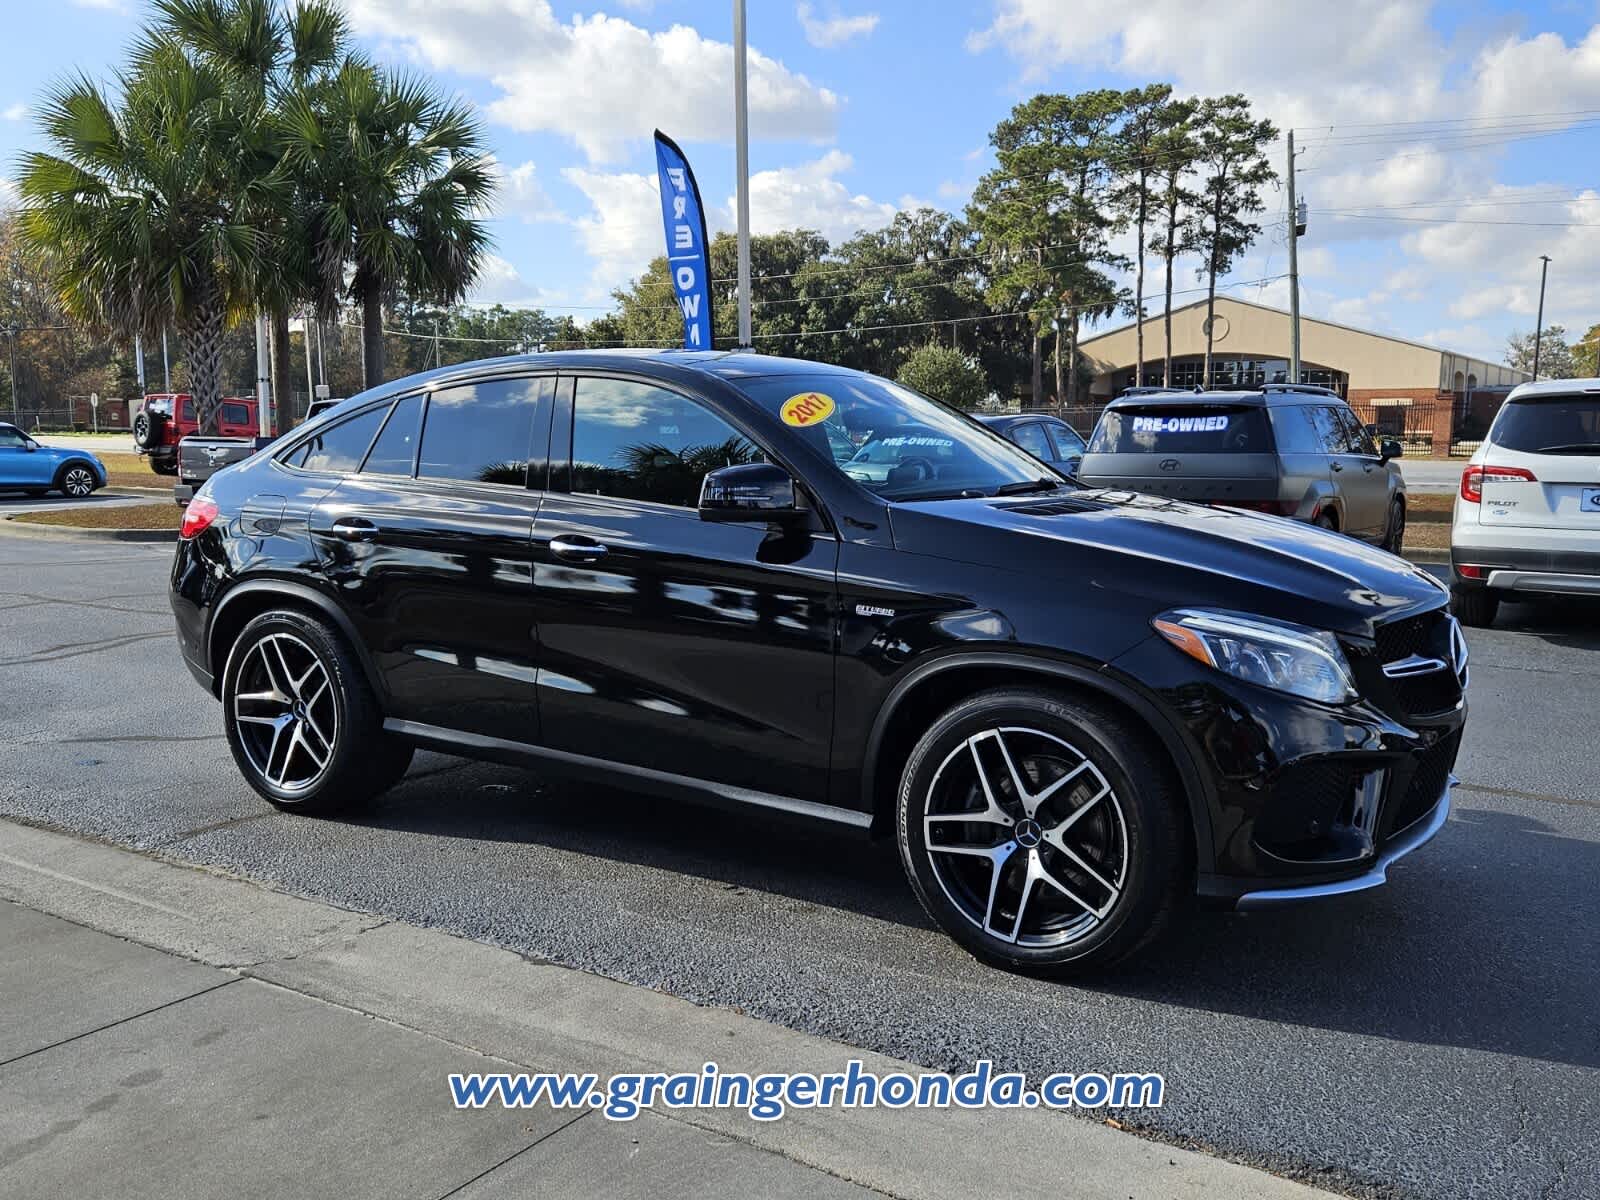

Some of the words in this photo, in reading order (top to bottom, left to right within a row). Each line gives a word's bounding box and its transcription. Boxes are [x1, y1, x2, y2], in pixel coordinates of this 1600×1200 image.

[788, 394, 826, 424] 2017
[1132, 416, 1228, 432] PRE-OWNED
[881, 437, 953, 447] PRE-OWNED
